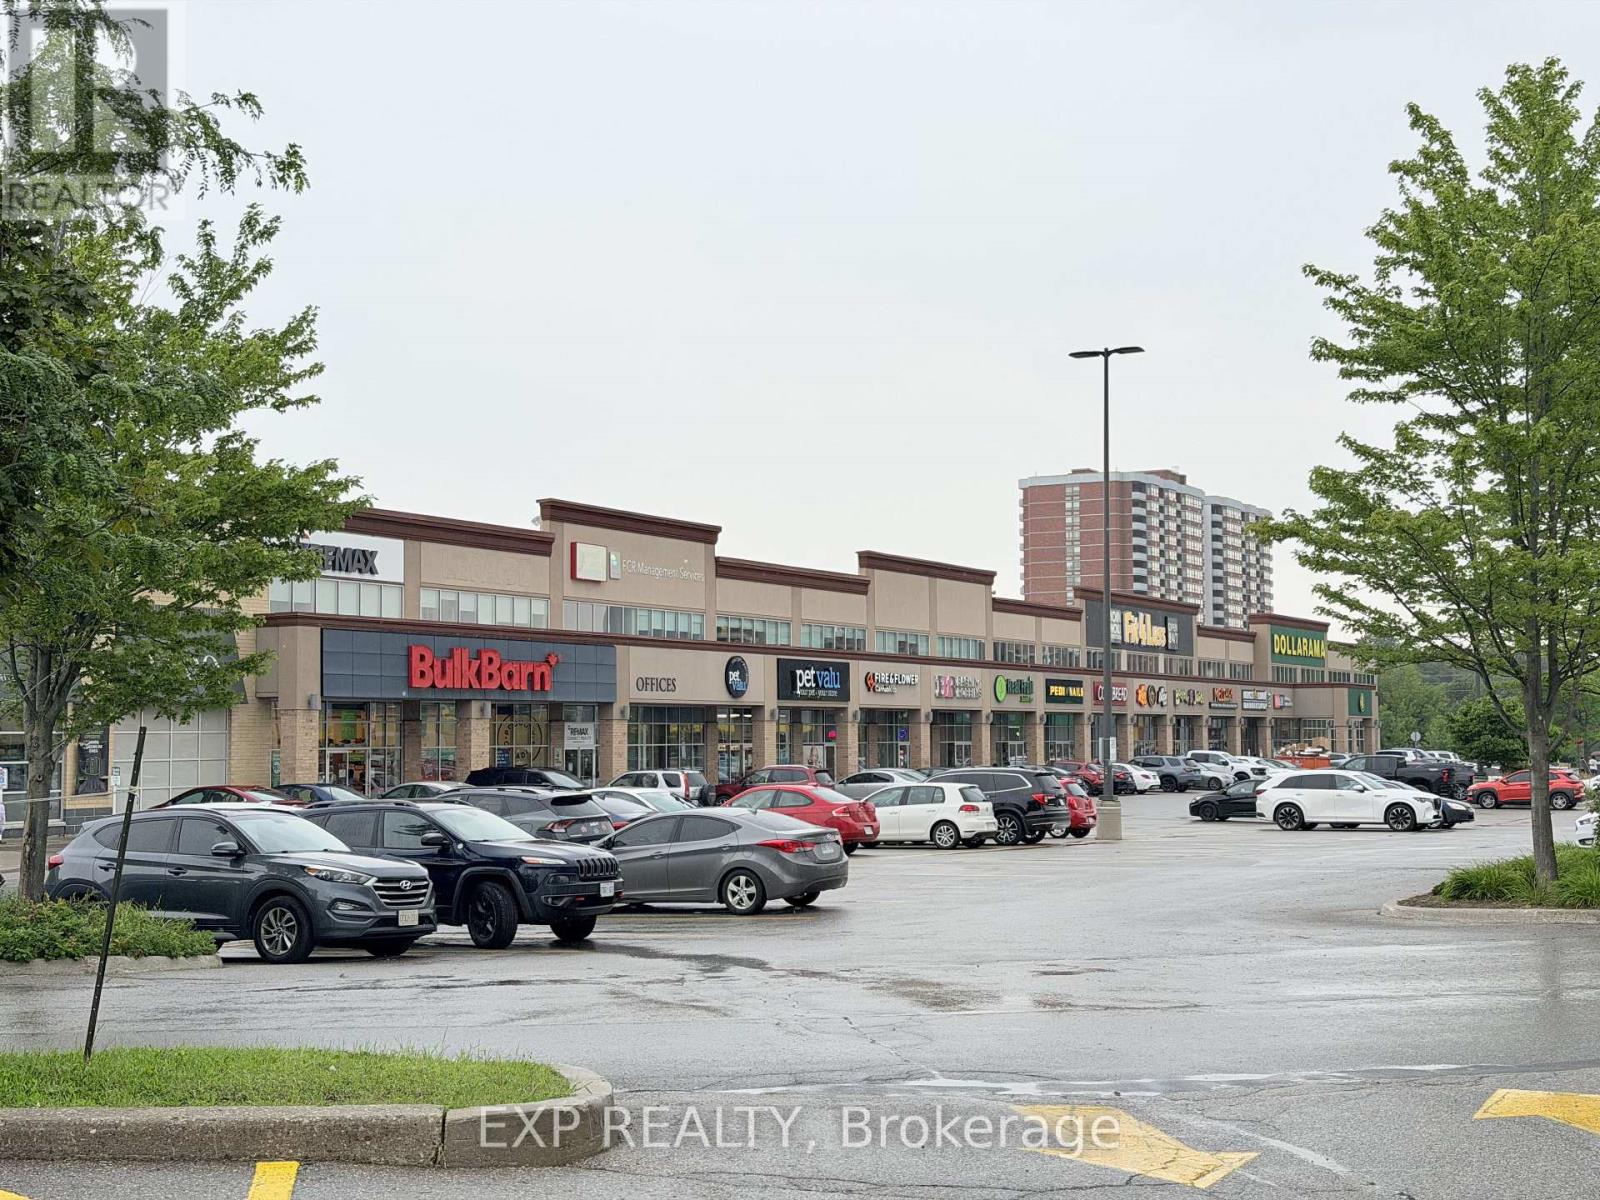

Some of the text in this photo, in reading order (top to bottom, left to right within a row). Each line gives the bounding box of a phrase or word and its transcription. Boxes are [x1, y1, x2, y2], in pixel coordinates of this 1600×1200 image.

[637, 561, 679, 579] Management
[1273, 633, 1326, 659] DOLLARAMA
[636, 676, 677, 692] OFFICES
[728, 670, 741, 684] pet
[795, 666, 840, 694] pet valu
[1049, 685, 1065, 696] PEDI
